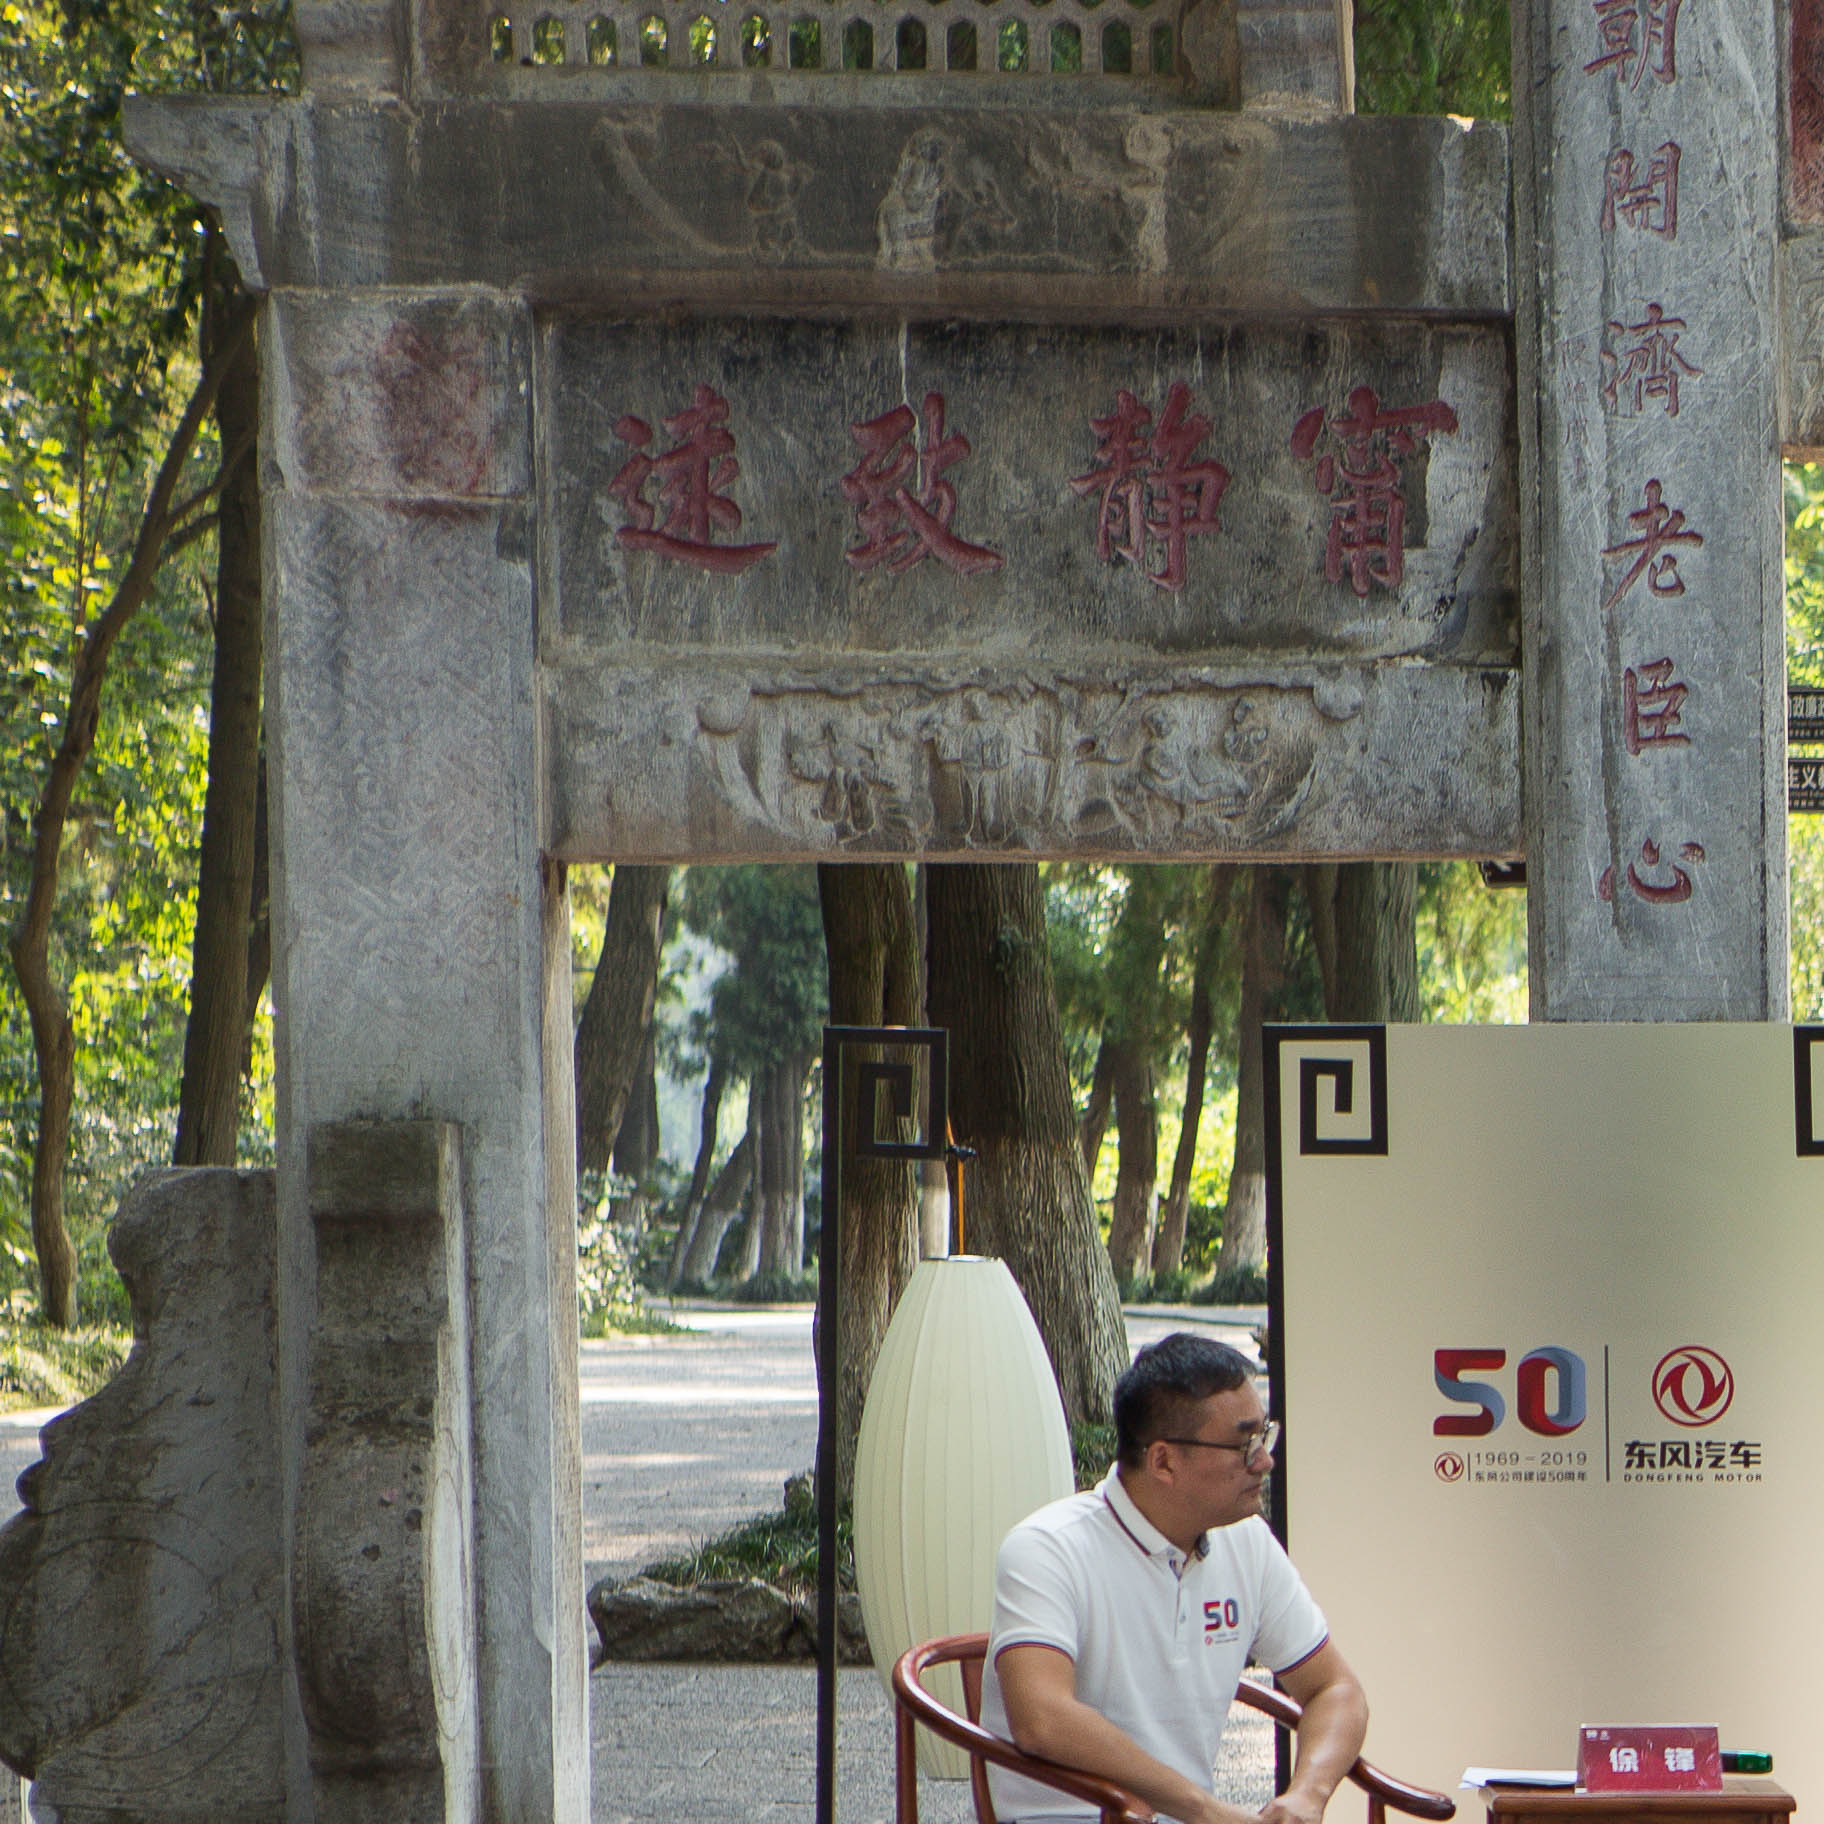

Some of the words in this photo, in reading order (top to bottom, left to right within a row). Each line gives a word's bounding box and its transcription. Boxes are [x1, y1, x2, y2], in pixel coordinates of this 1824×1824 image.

[1433, 1345, 1586, 1437] 50
[1624, 1440, 1762, 1469] 东风汽车
[1623, 1473, 1704, 1483] DONGFENG
[1714, 1473, 1762, 1483] MOTOR
[1203, 1598, 1239, 1631] 50
